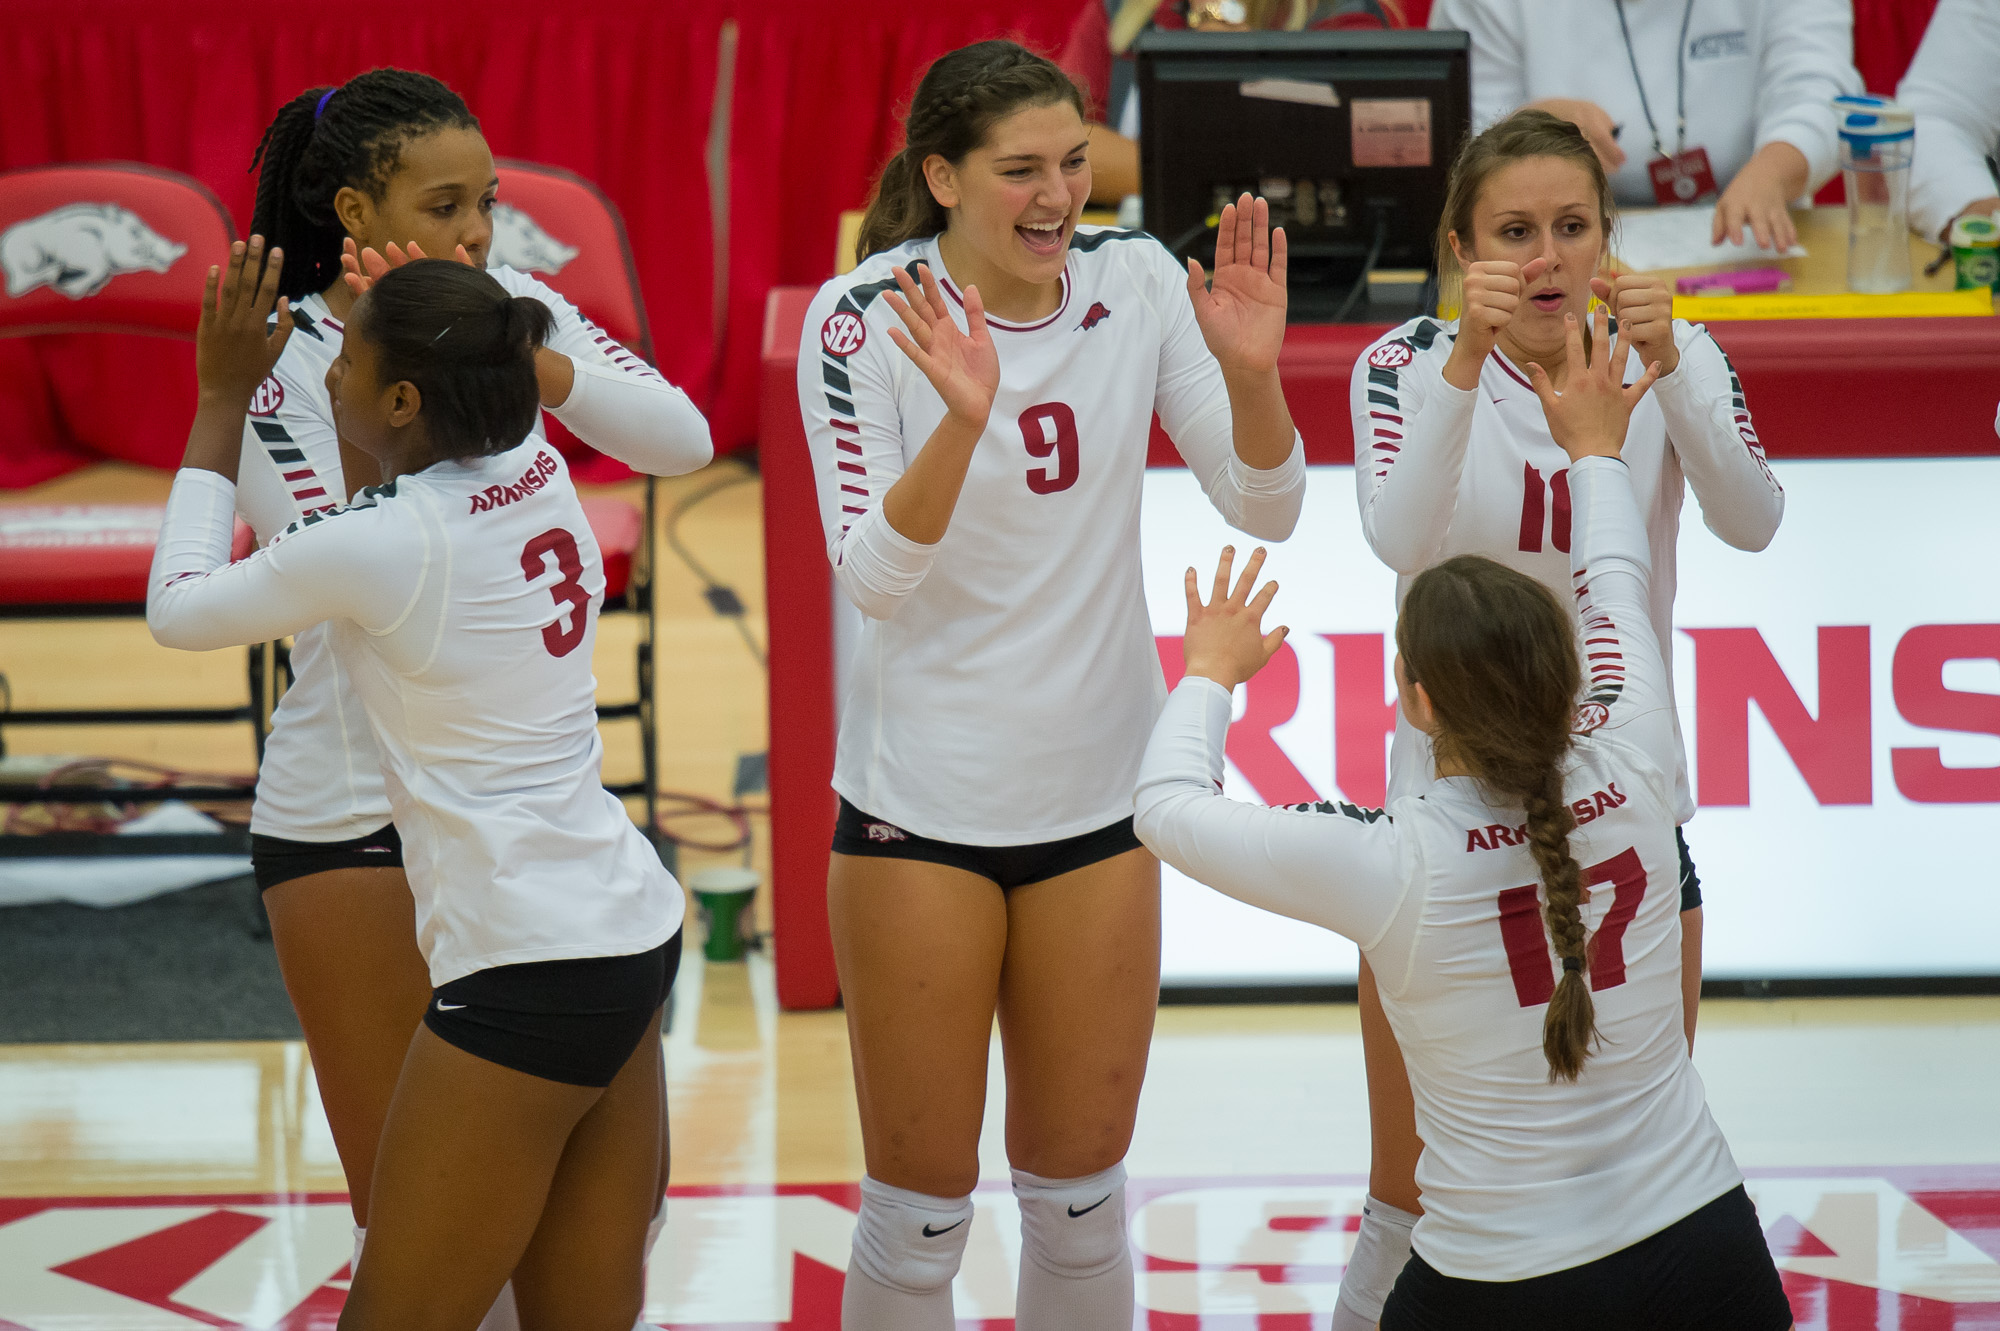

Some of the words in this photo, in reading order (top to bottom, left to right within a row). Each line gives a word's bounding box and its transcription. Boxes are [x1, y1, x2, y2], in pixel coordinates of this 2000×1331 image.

[823, 313, 864, 354] SEC
[1370, 343, 1410, 366] SEC
[249, 376, 282, 414] EC
[1018, 401, 1080, 496] 9
[520, 527, 592, 658] 3
[1465, 782, 1627, 853] ARKSAS
[1498, 845, 1648, 1008] 17
